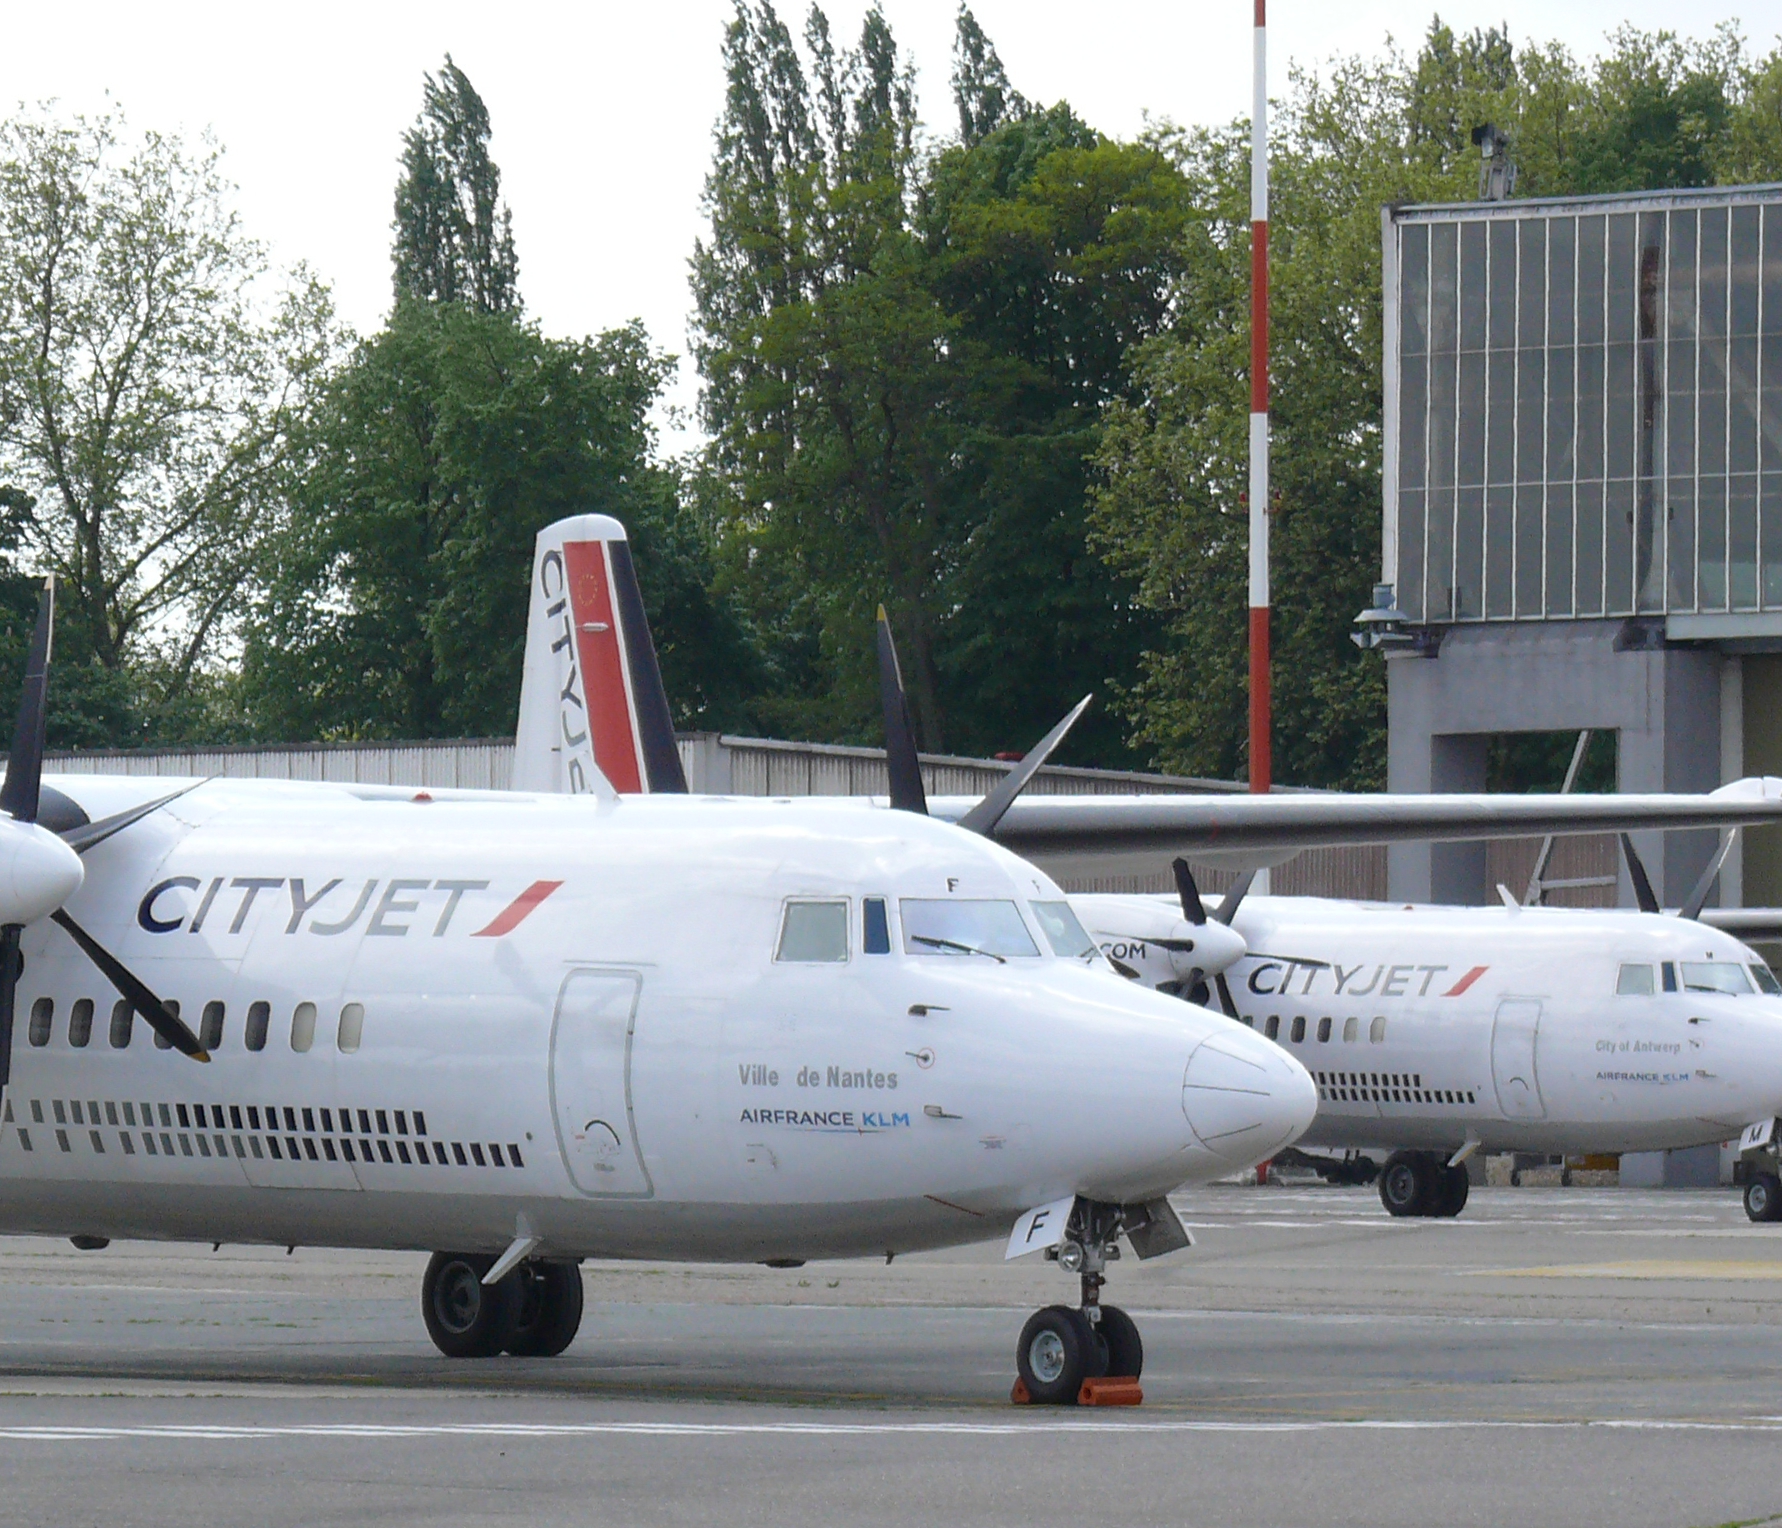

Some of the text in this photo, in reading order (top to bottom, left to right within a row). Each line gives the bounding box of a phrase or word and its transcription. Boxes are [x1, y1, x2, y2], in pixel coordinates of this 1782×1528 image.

[137, 875, 491, 937] CITYJET
[1247, 963, 1448, 997] CITYJET
[1595, 1040, 1681, 1055] City of Antwerp
[738, 1064, 898, 1090] Ville de Nantes
[1596, 1071, 1689, 1081] AIRFRANCE KLM
[739, 1108, 910, 1128] AIRFRANCE KLM
[1748, 1124, 1764, 1143] M
[1025, 1210, 1050, 1244] F
